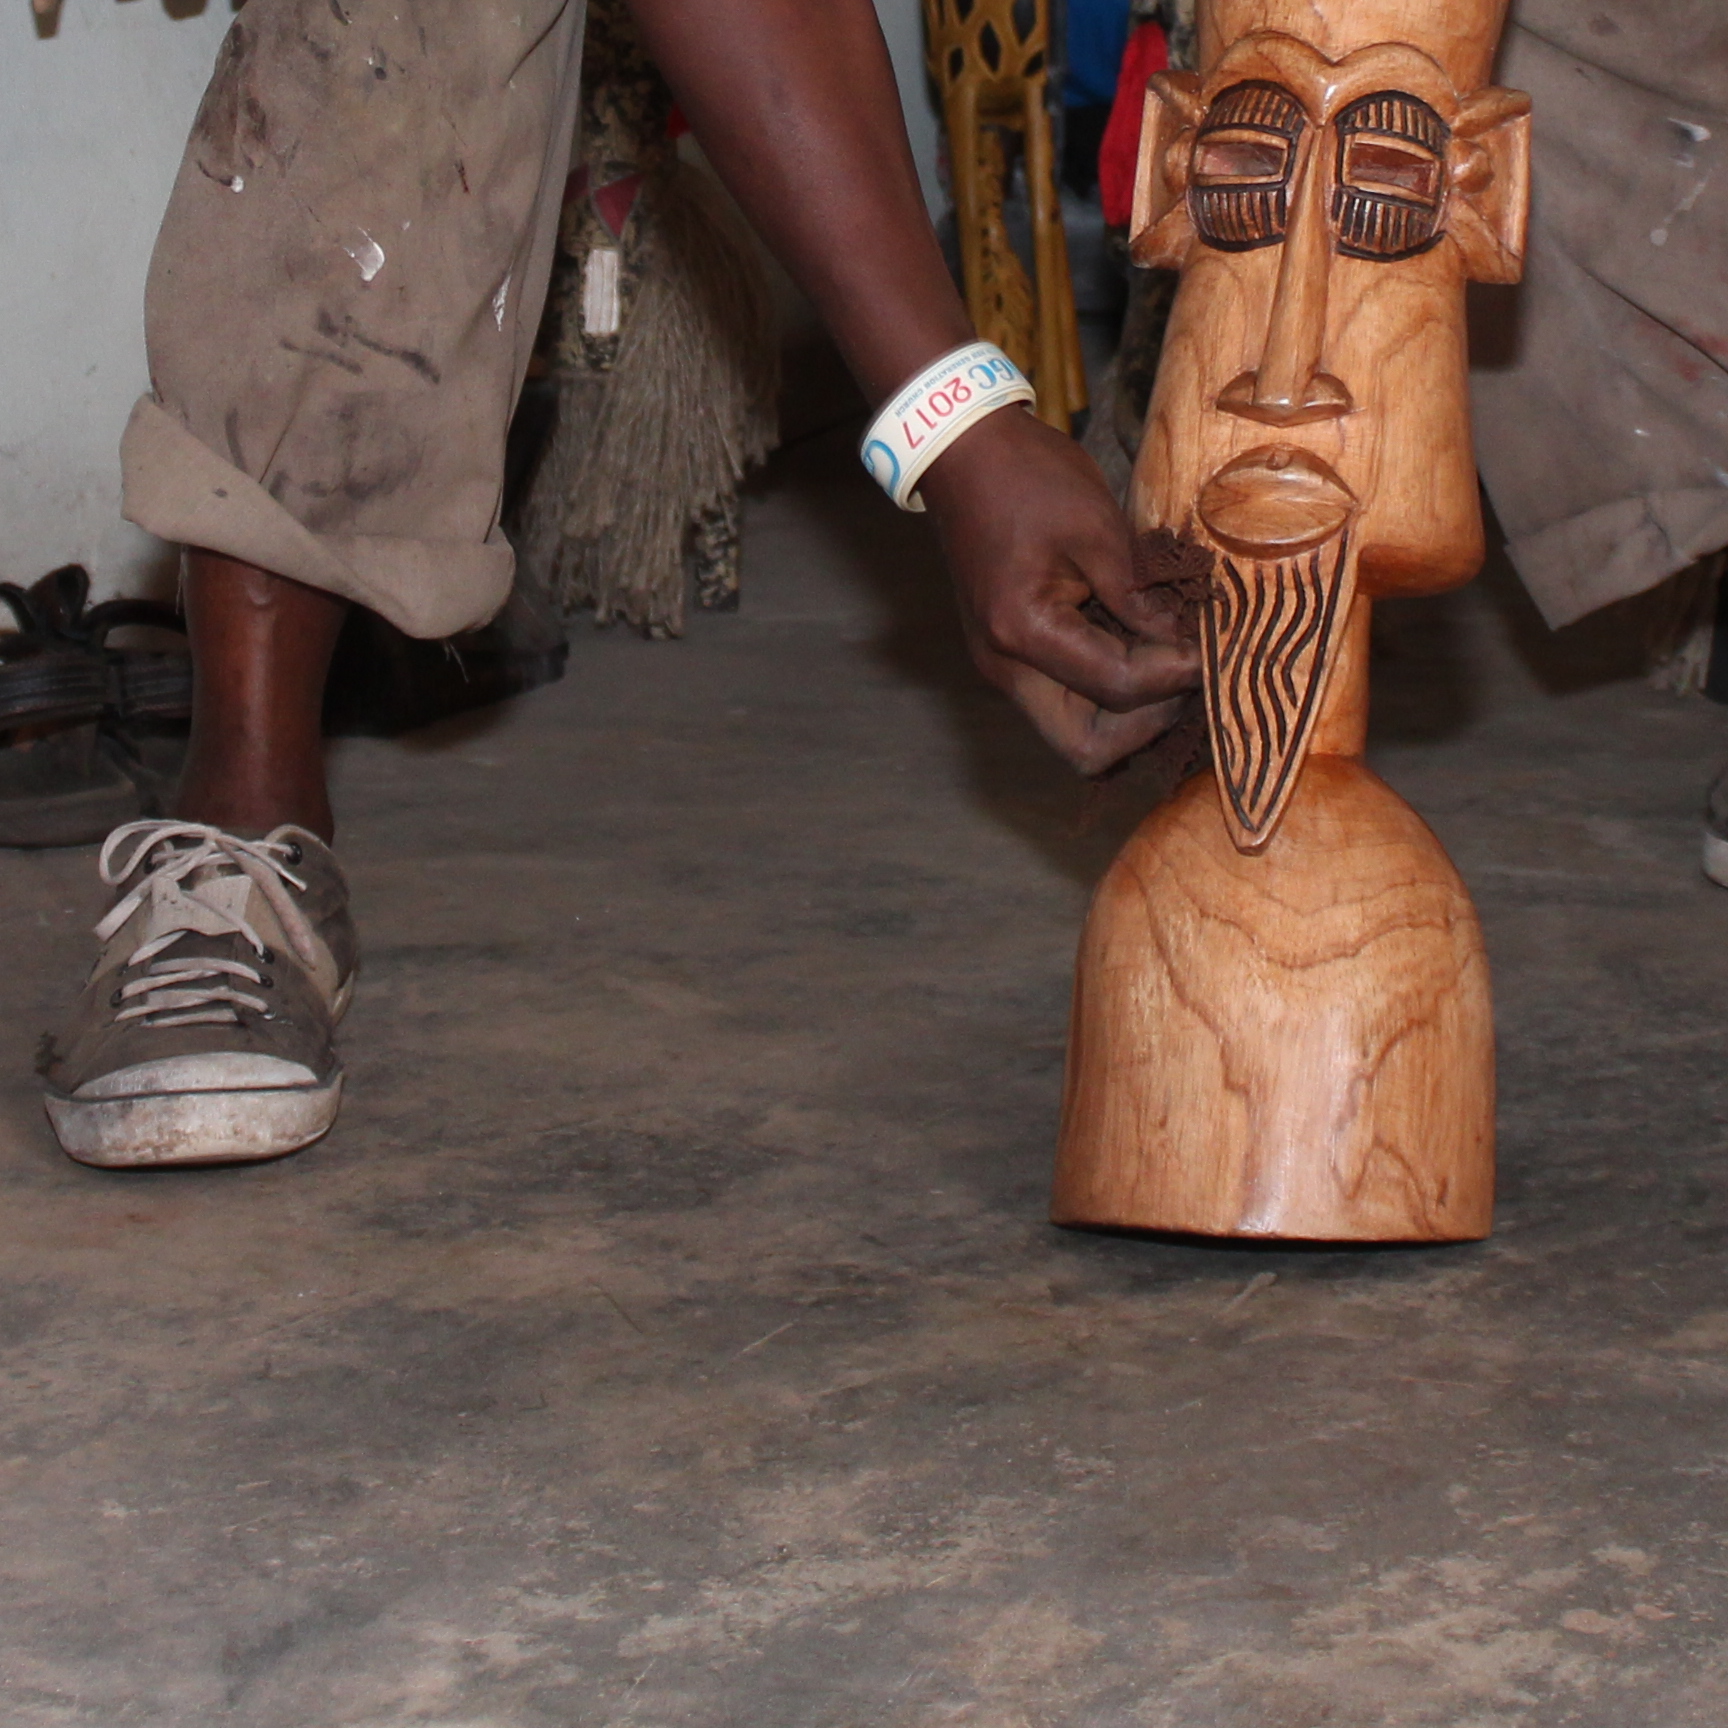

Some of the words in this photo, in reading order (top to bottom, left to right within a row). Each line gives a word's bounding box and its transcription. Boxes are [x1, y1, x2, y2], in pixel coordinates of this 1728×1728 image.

[923, 355, 970, 388] GENERATION
[968, 357, 1018, 389] GC
[895, 388, 923, 418] CHURCH
[900, 376, 972, 450] 2017
